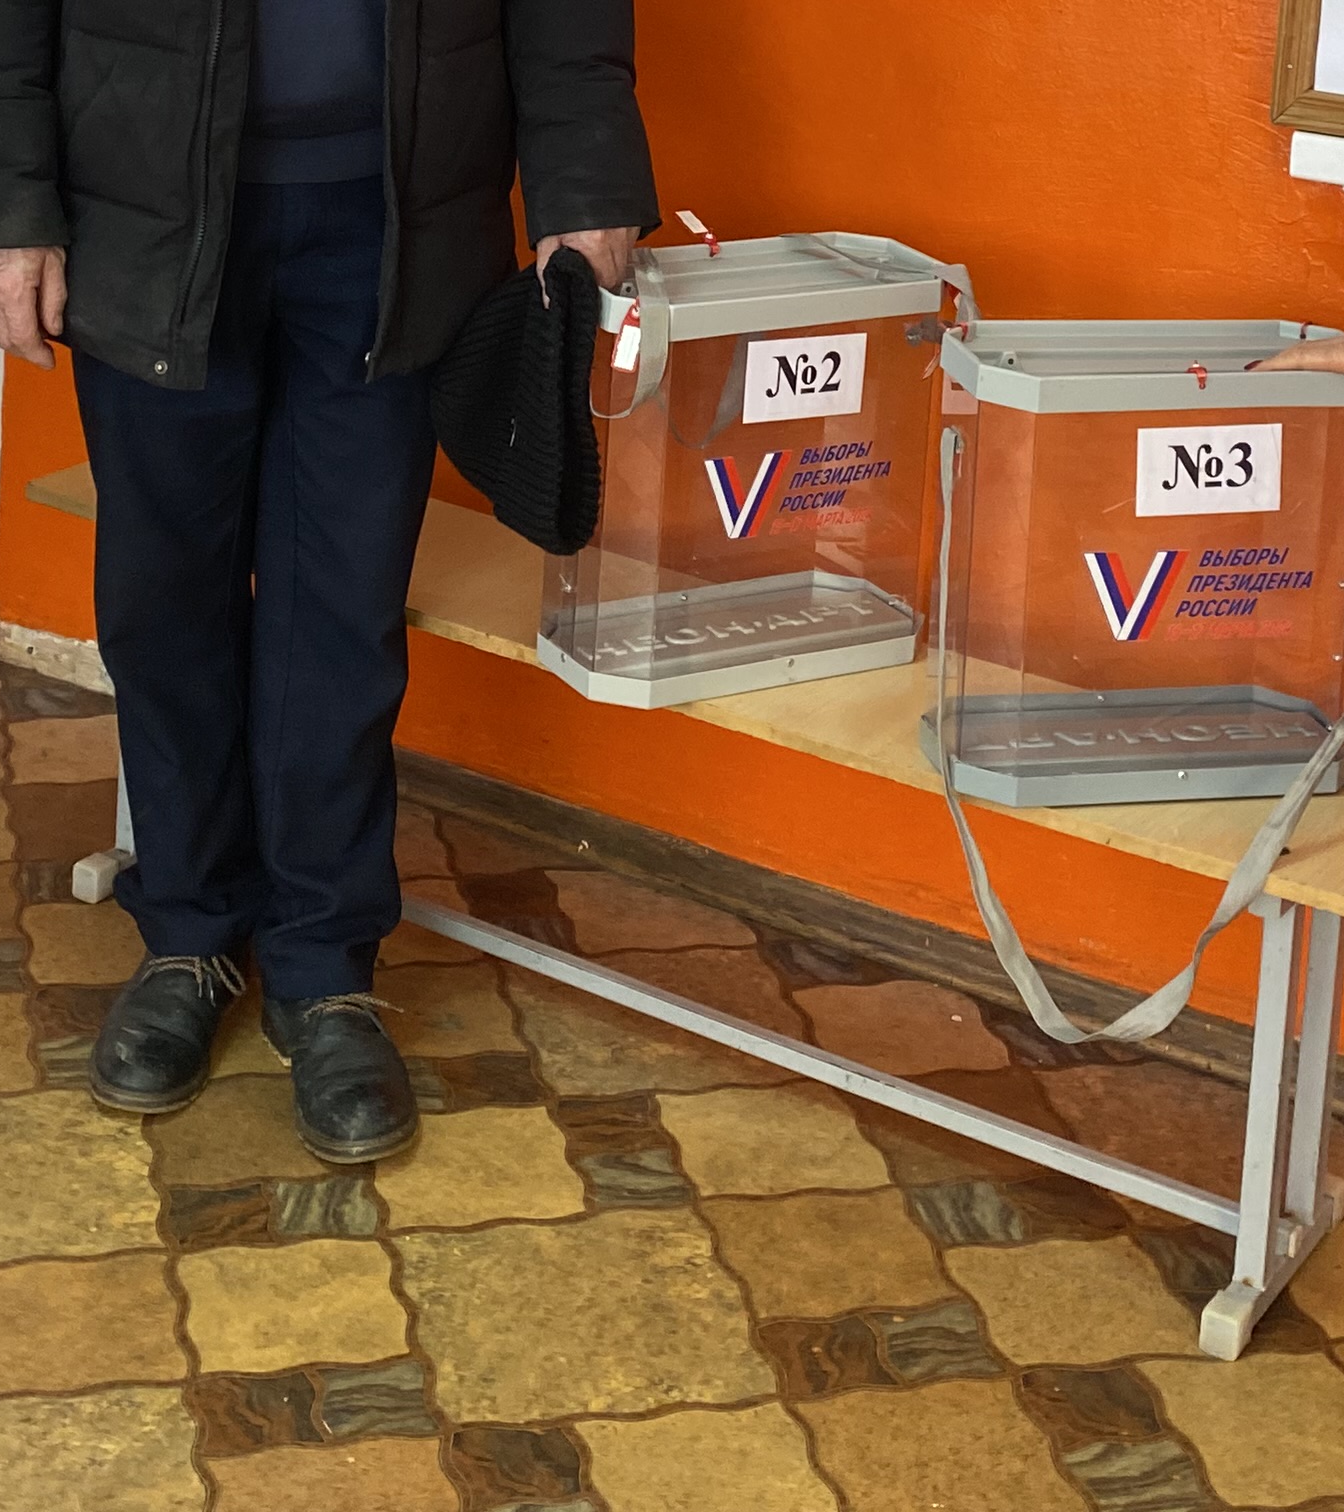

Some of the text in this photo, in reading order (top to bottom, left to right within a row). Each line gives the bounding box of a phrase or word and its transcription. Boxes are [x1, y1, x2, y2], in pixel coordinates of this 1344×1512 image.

[800, 441, 873, 465] ВЫБОРЫ
[789, 461, 891, 489] ПРЕЗИДЕНТА
[779, 489, 846, 513] РОССИИ
[1199, 547, 1289, 567] ВЫБОРЫ
[1187, 571, 1314, 593] ПРЕЗИДЕНТА
[1175, 598, 1258, 617] РОССИИ
